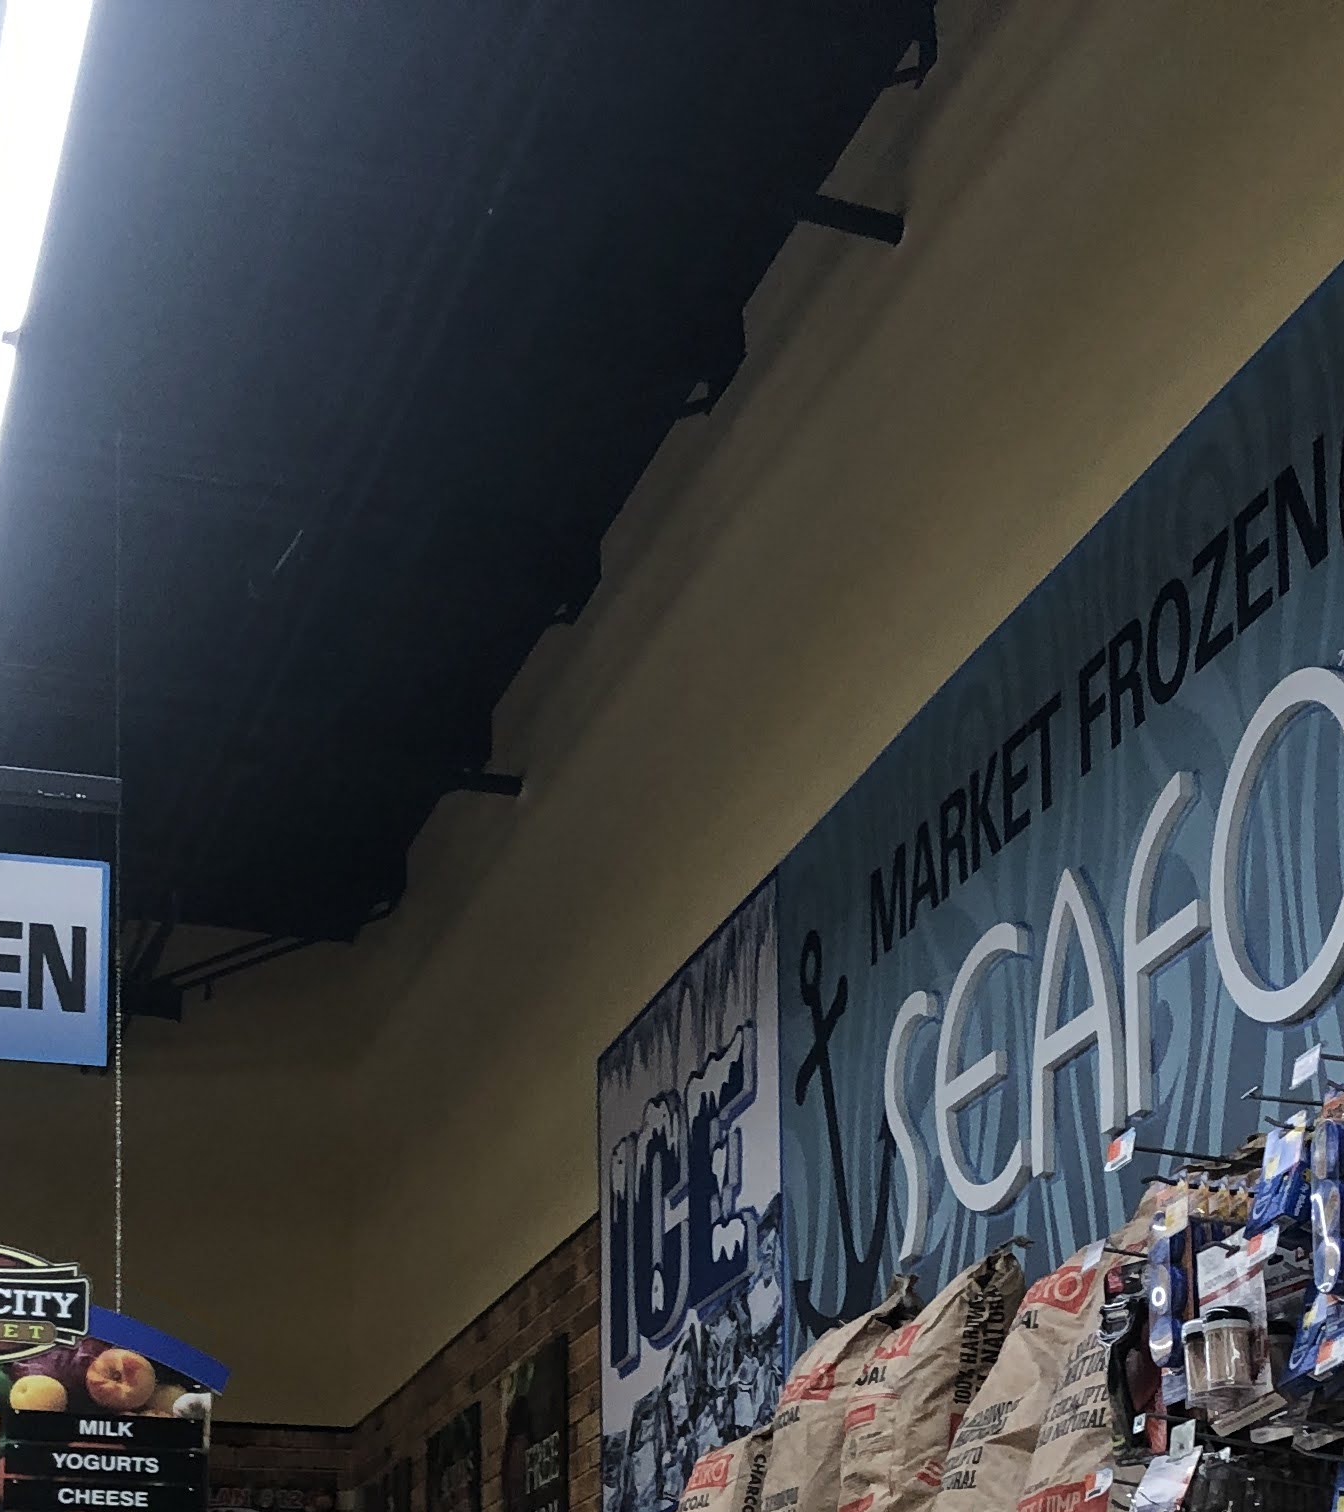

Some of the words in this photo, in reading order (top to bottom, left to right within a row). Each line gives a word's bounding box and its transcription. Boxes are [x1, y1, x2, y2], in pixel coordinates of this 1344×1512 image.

[869, 694, 1062, 965] MARKET
[1078, 439, 1327, 776] FROZEN
[610, 1019, 756, 1380] ICE
[79, 1420, 134, 1438] MILK
[52, 1452, 159, 1474] YOGURTS
[58, 1488, 148, 1508] CHEESE
